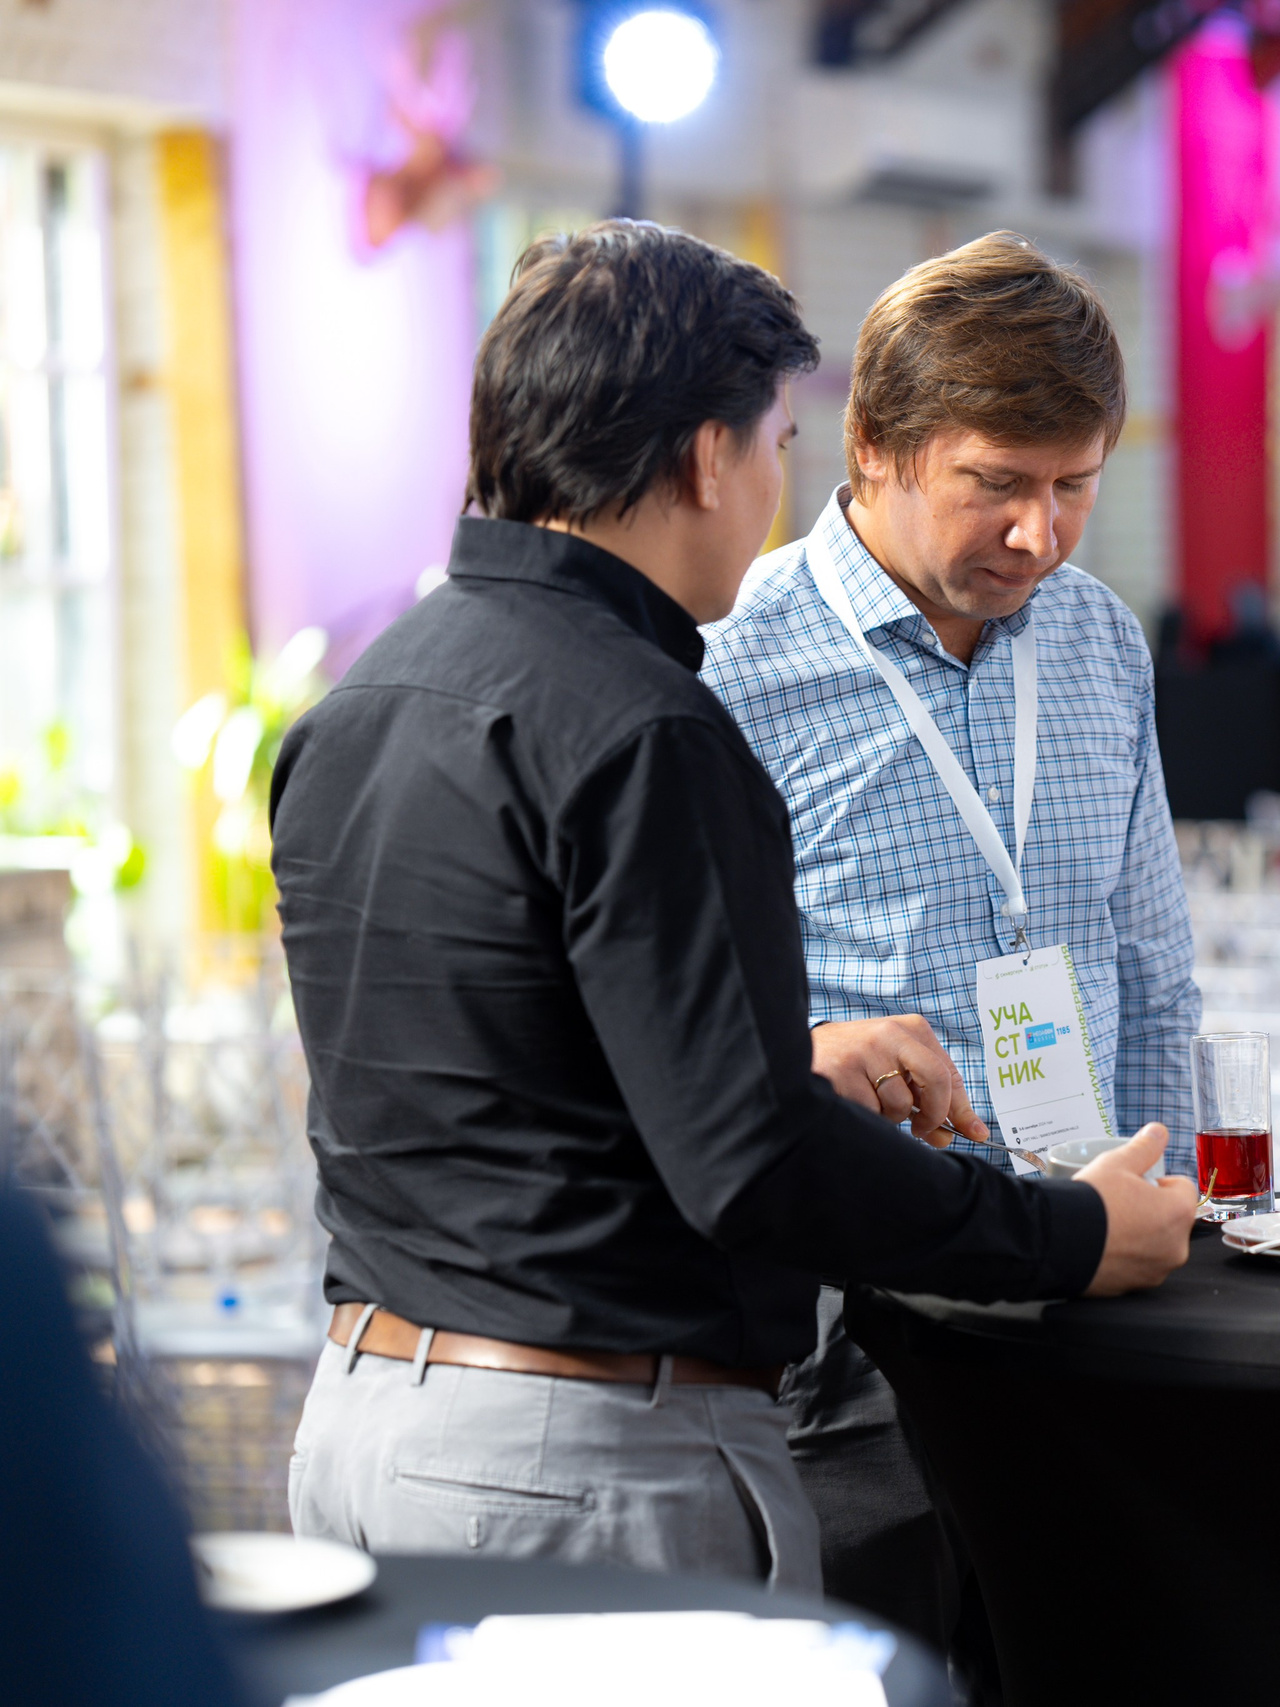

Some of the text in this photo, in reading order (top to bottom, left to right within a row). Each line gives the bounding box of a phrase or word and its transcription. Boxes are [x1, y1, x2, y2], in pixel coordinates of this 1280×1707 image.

[989, 1002, 1033, 1031] УЧА
[995, 1033, 1021, 1059] СТ
[1061, 945, 1115, 1139] ИНЕРГИУМ КОНФЕРЕНЦИЯ
[998, 1057, 1045, 1088] НИК
